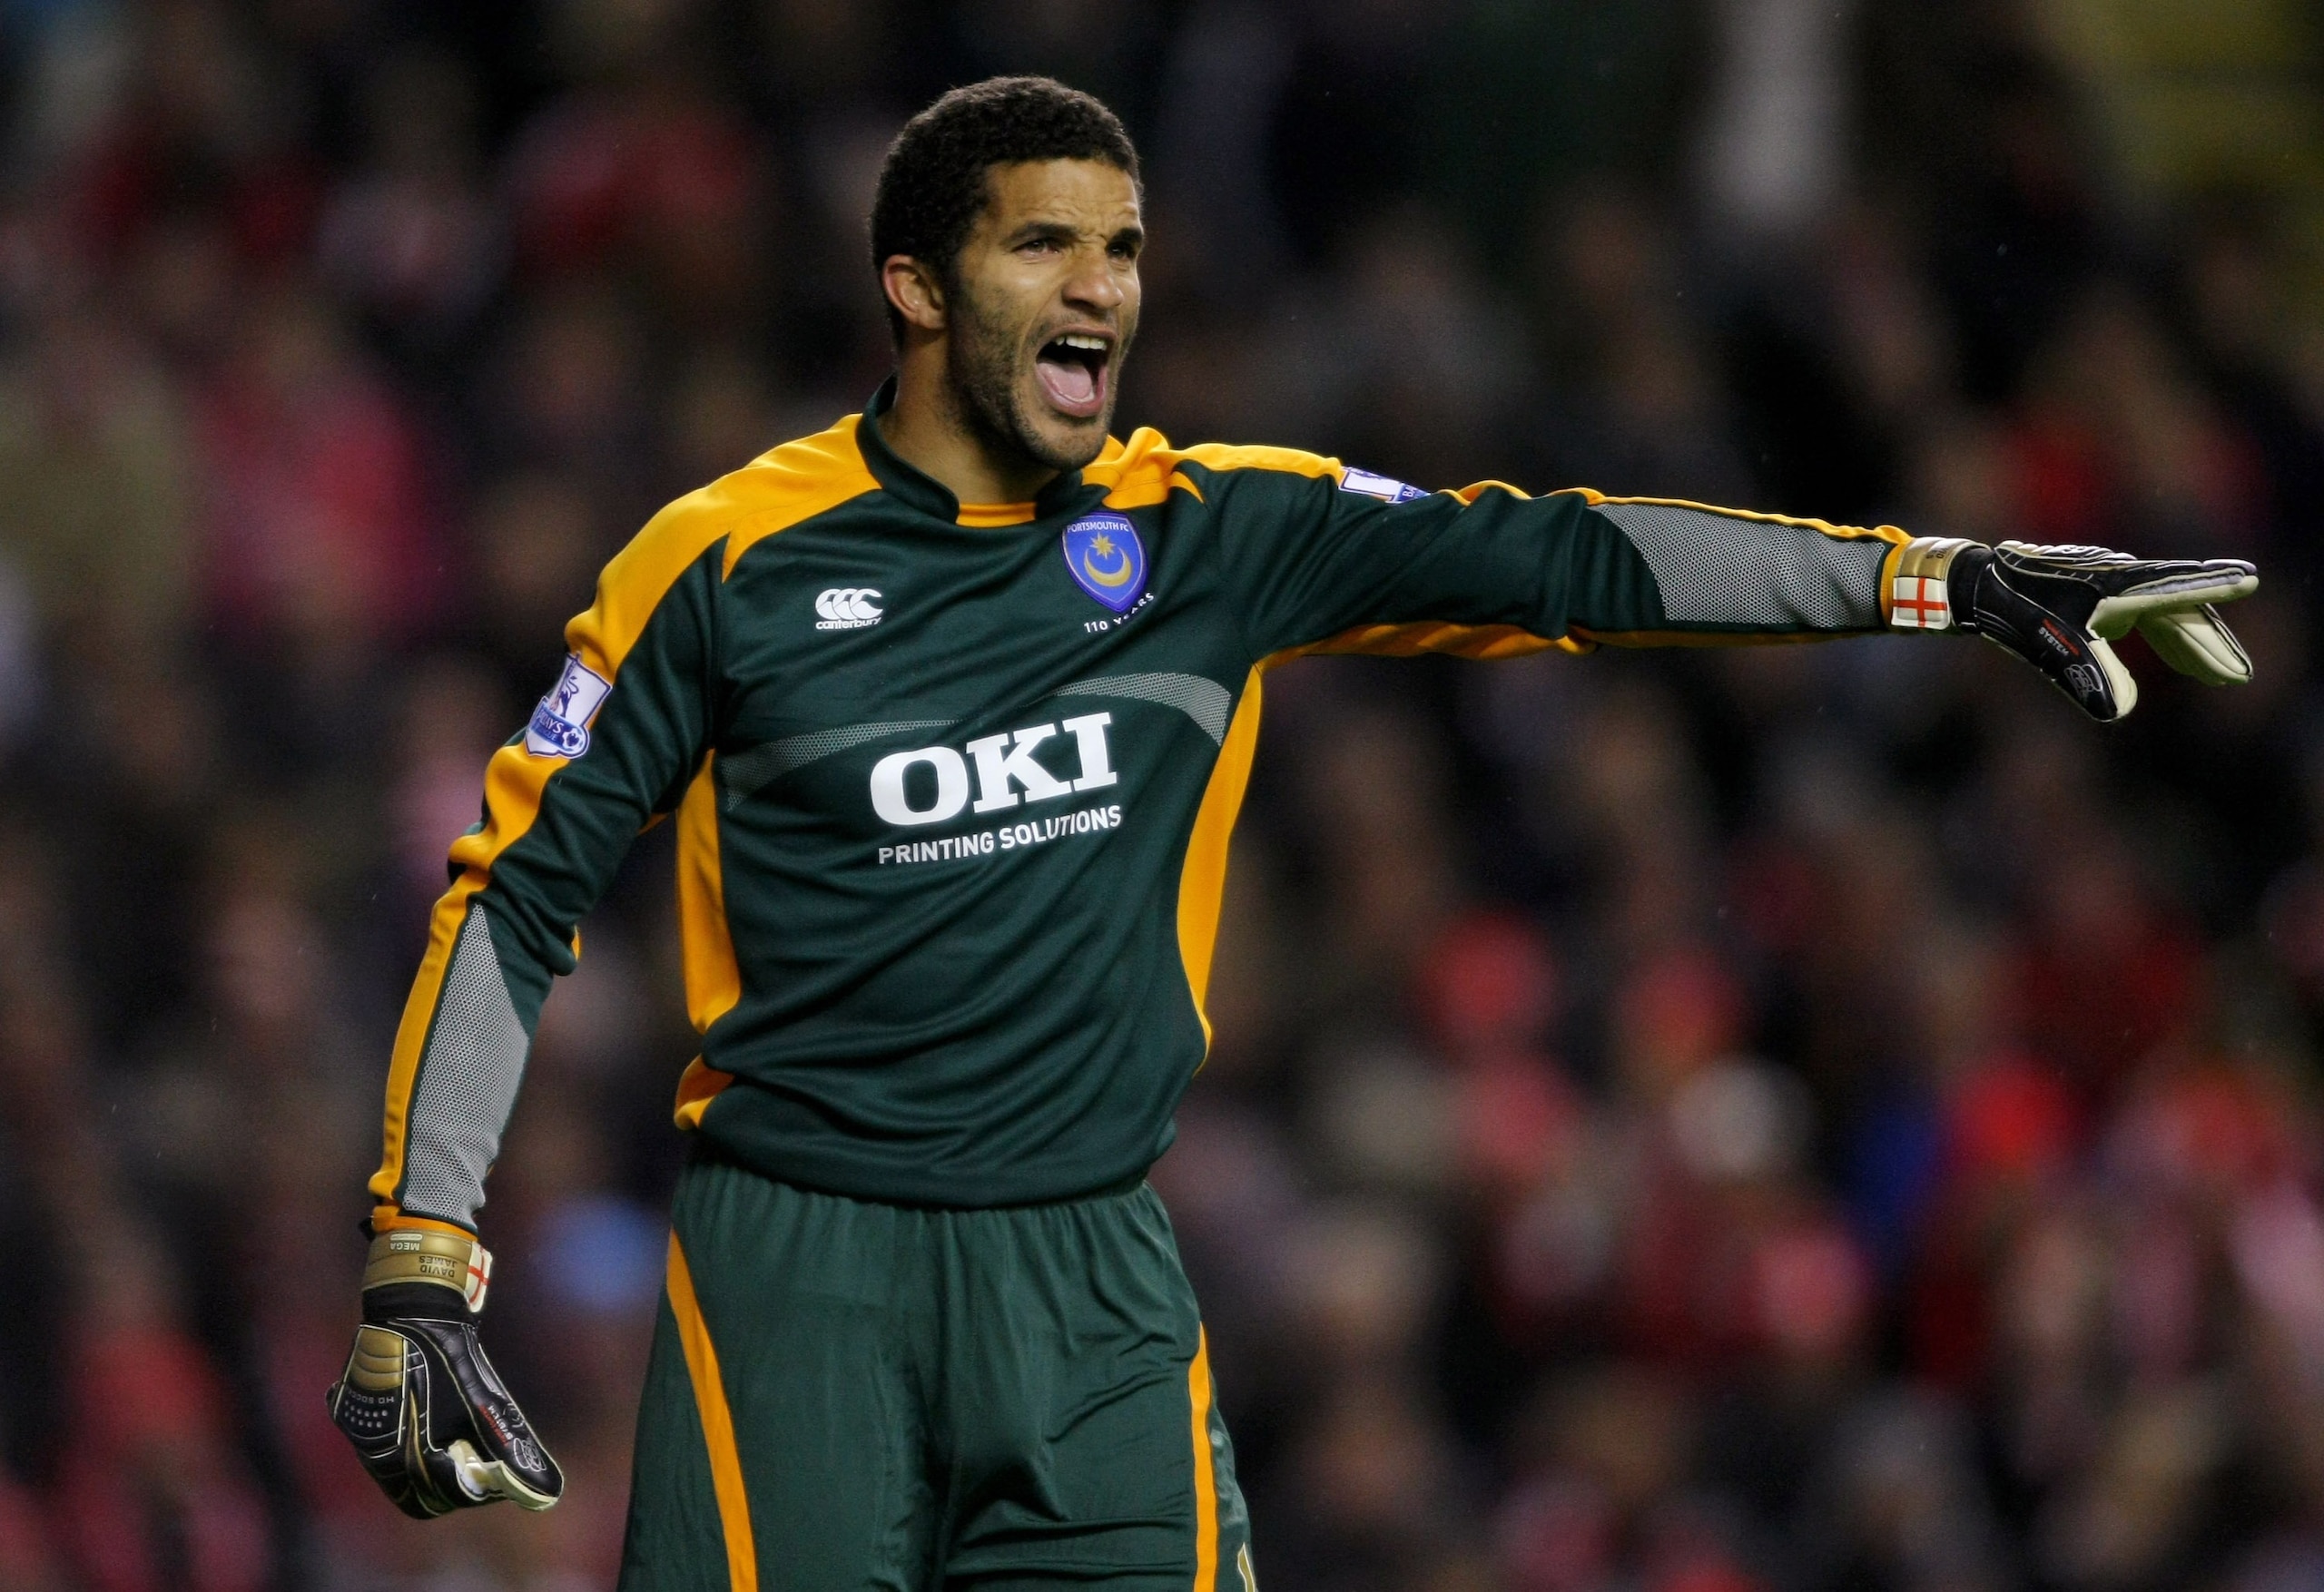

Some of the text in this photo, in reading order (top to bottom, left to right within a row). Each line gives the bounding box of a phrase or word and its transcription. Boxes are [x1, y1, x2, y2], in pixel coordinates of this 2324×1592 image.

[1067, 521, 1130, 533] PORTSMOUTH FC
[1083, 592, 1156, 634] 110 YEARS
[815, 616, 882, 630] canterbury
[2038, 626, 2070, 656] SYSTEM
[870, 712, 1118, 826] OKI
[878, 804, 1123, 866] PRINTING SOLUTIONS
[389, 1242, 420, 1251] MEGA
[419, 1255, 458, 1267] JAMES
[419, 1264, 455, 1278] DAVID
